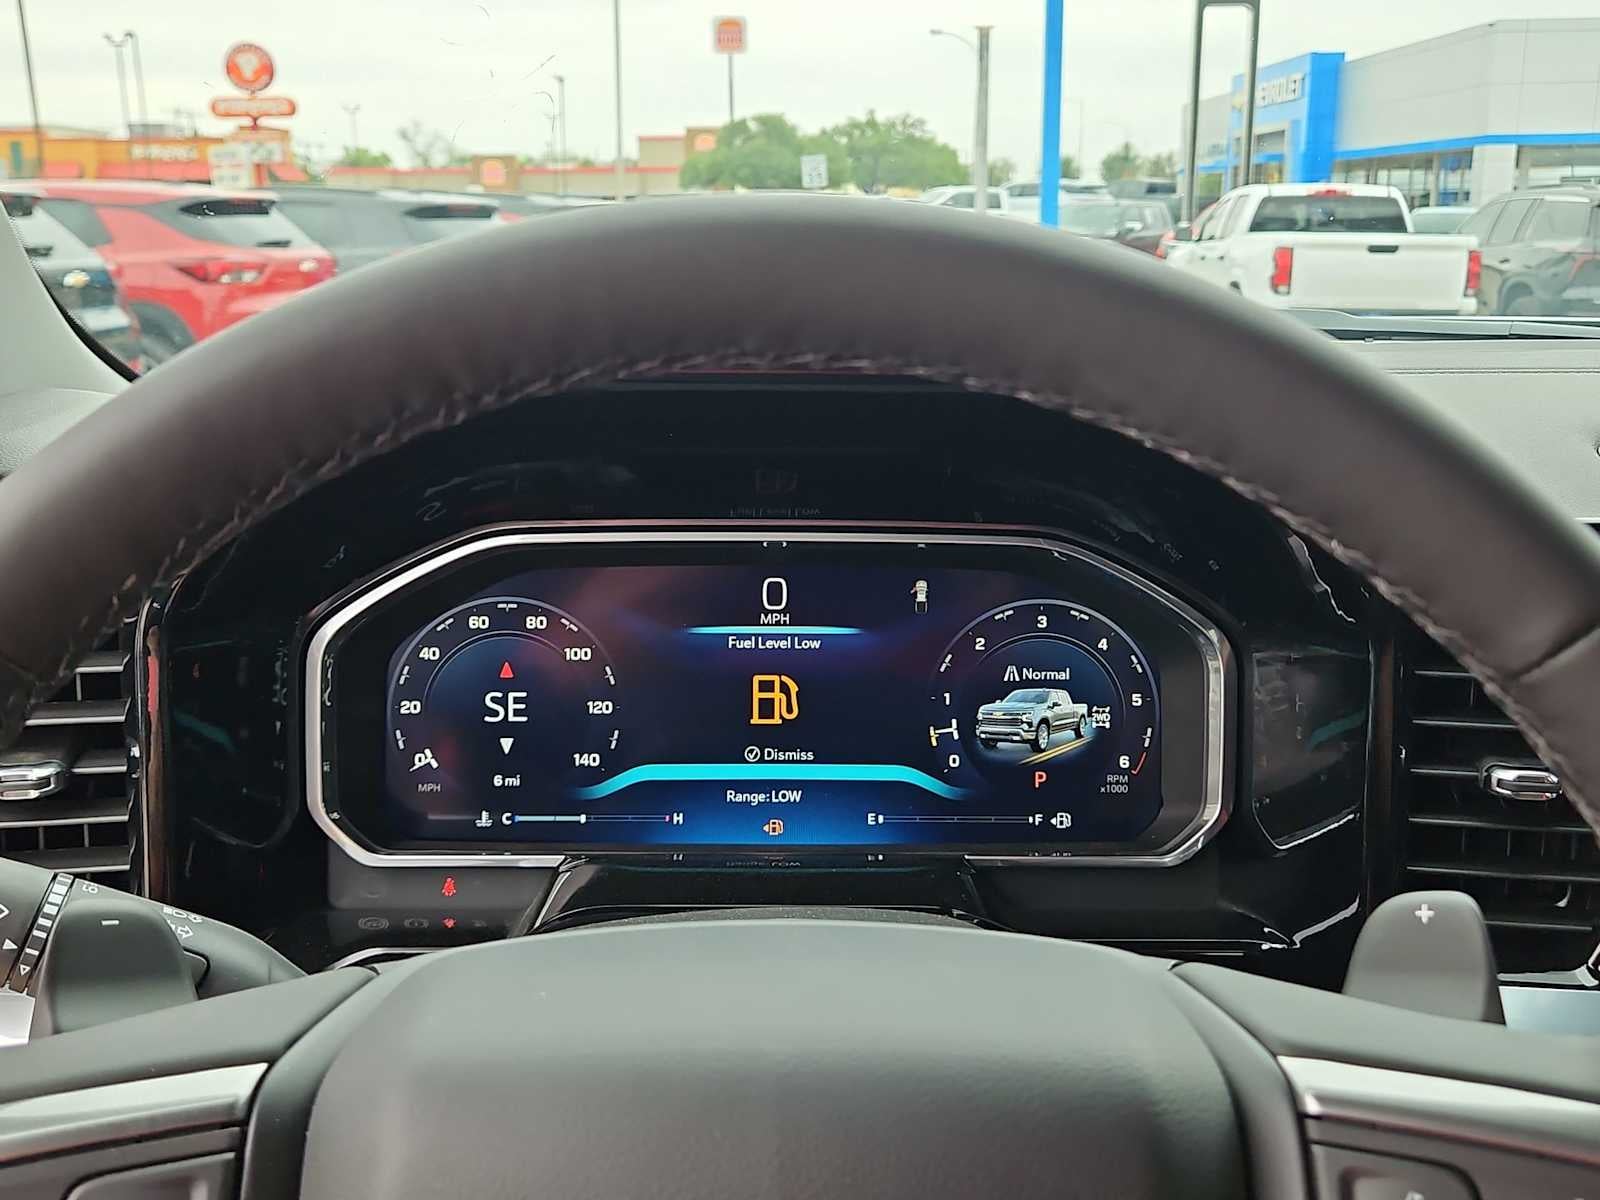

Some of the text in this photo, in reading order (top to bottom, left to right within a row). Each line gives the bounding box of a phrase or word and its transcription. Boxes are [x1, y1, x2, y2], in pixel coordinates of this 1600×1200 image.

[762, 577, 788, 611] 0
[468, 615, 490, 630] 60
[525, 615, 548, 630] 80
[760, 612, 790, 625] MPH
[1036, 615, 1048, 629] 3
[728, 635, 822, 650] Fuel Level Low
[974, 637, 986, 651] 2
[1097, 637, 1109, 651] 4
[418, 647, 440, 661] 40
[563, 647, 592, 661] 100
[1022, 667, 1070, 681] Normal
[943, 692, 950, 706] 1
[1131, 693, 1143, 707] 5
[399, 700, 422, 715] 20
[483, 691, 529, 723] SE
[586, 700, 613, 715] 120
[1092, 713, 1111, 722] 2WD
[573, 753, 601, 767] 140
[764, 747, 815, 761] Dismiss
[948, 754, 960, 768] 0
[1119, 755, 1130, 769] 6
[493, 774, 521, 787] 6 mi
[1034, 771, 1047, 788] P
[1106, 774, 1129, 784] RPM
[417, 783, 441, 792] MPH
[1100, 784, 1129, 794] x1000
[726, 789, 803, 805] Range: LOW
[501, 812, 513, 825] C
[672, 812, 684, 826] H
[867, 812, 877, 826] E
[1034, 813, 1044, 826] F
